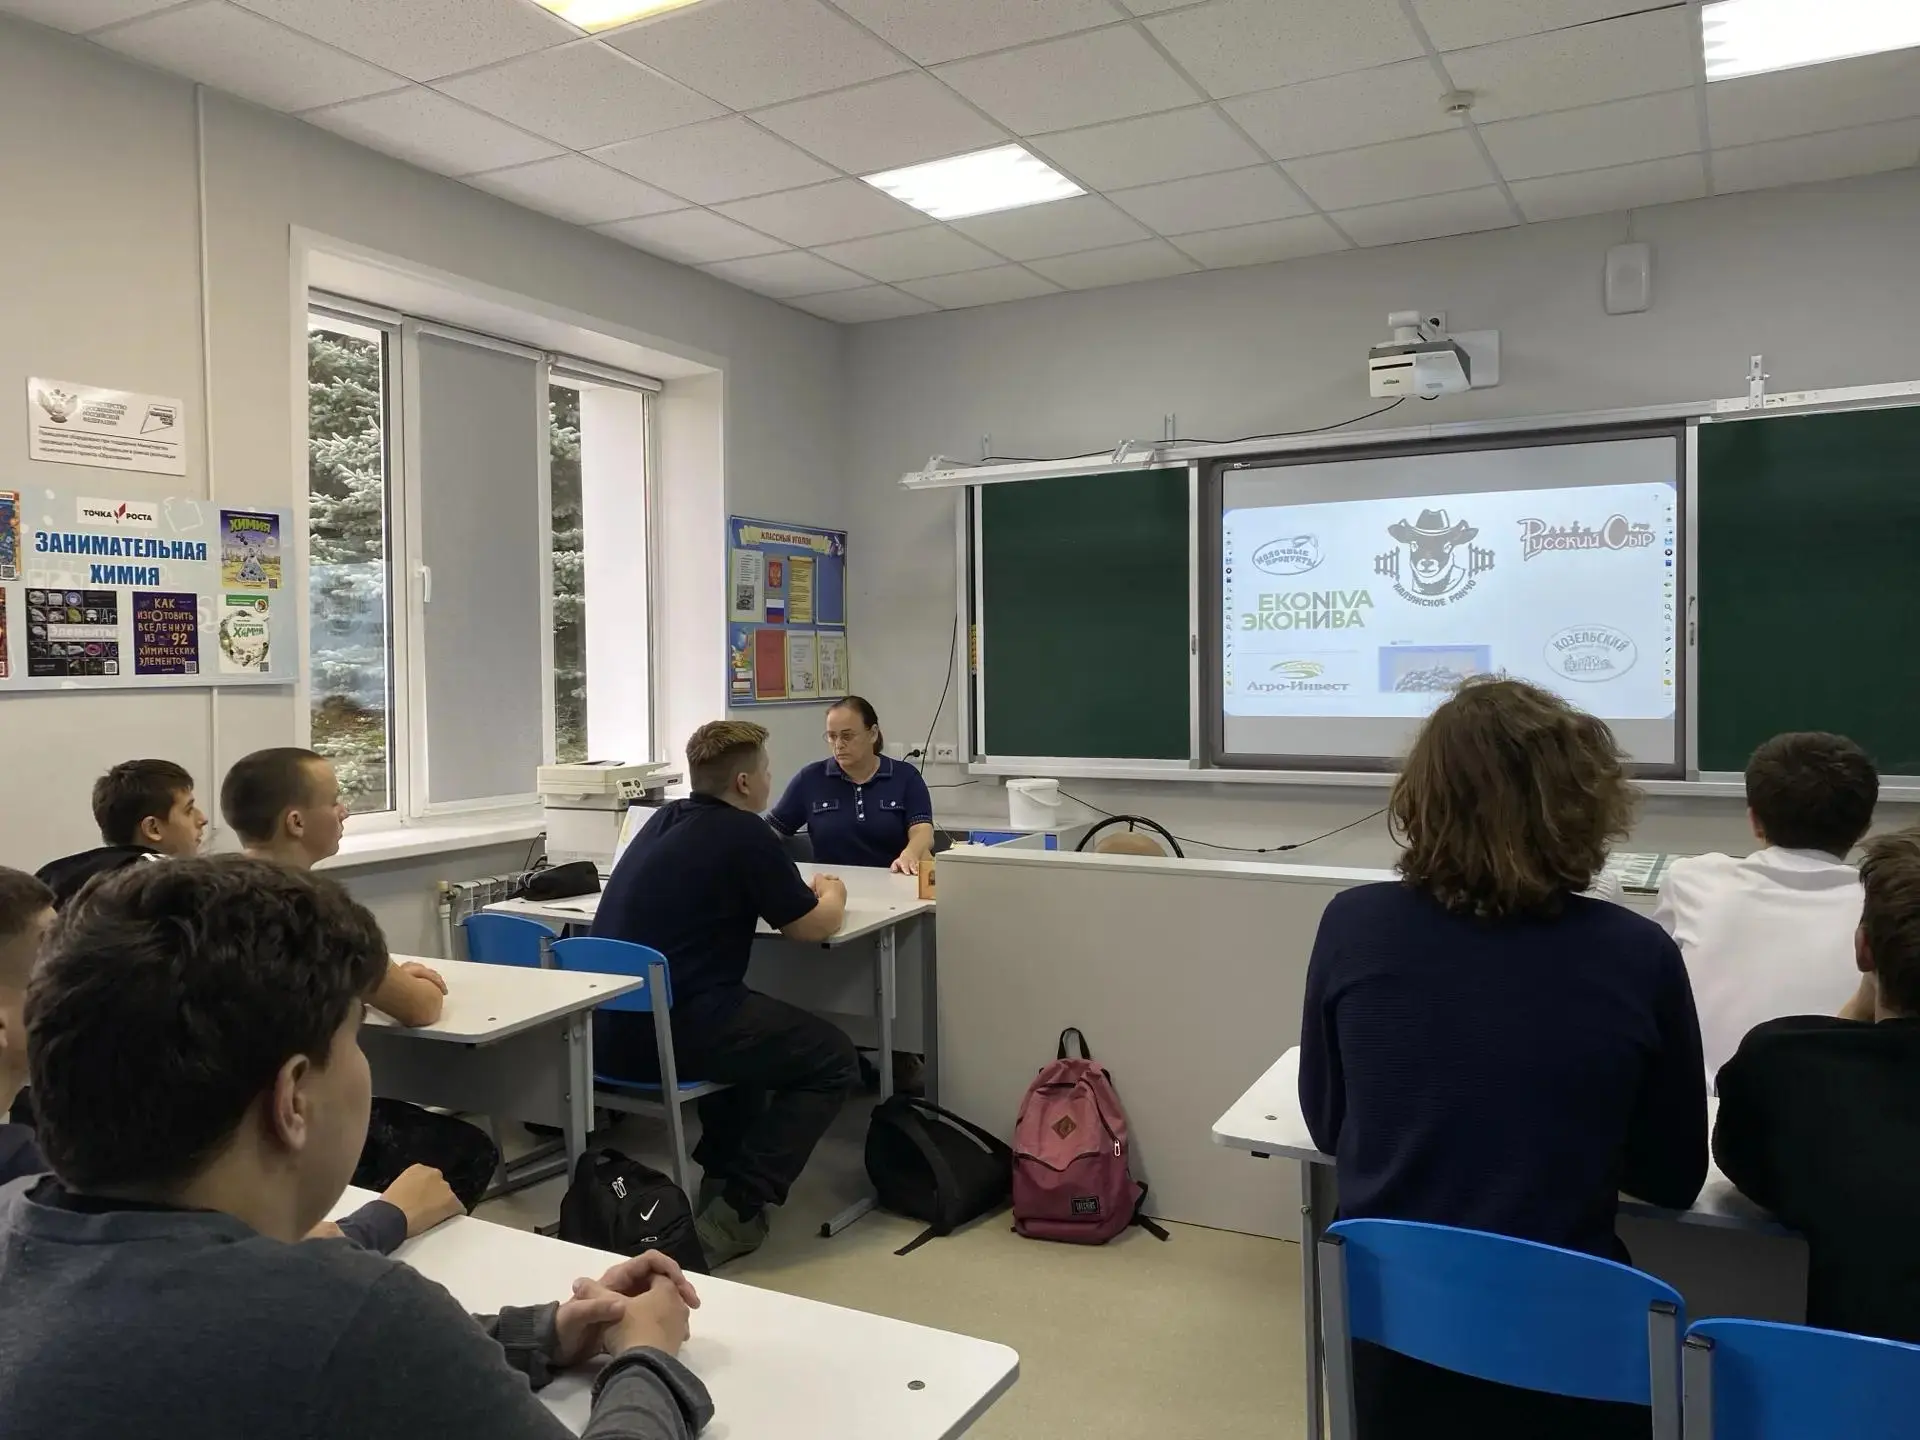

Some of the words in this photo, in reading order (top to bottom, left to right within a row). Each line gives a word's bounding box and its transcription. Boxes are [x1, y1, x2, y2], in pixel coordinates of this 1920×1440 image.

[83, 509, 112, 518] ТОЧКА
[126, 512, 152, 521] РОСТА
[229, 518, 272, 534] ХИМИЯ
[761, 531, 791, 542] КЛАССНЫЙ
[792, 535, 812, 545] УГОЛОК
[1517, 518, 1600, 562] Русский
[1602, 514, 1656, 550] Сыр
[35, 531, 207, 560] ЗАНИМАТЕЛЬНАЯ
[1256, 549, 1309, 565] МОЛОЧНЫЕ
[1265, 555, 1317, 568] ПРОДУКТЫ
[90, 564, 160, 586] ХИМИЯ
[1258, 589, 1375, 611] EKONIVA
[1393, 583, 1447, 607] КАЛУЖСКОЕ
[1448, 579, 1477, 603] РАНЧО
[154, 598, 175, 609] КАК
[137, 610, 194, 622] ИЗГОТОВИТЬ
[1241, 609, 1365, 631] ЭКОНИВА
[138, 622, 195, 632] ВСЕЛЕННУЮ
[144, 633, 156, 643] ИЗ
[171, 632, 188, 645] 92
[1553, 631, 1631, 652] КОЗЕЛЬСКИЙ
[139, 646, 196, 655] ХИМИЧЕСКИХ
[139, 656, 186, 667] ЭЛЕМЕНТОВ
[1247, 680, 1350, 692] Агро-Инвест
